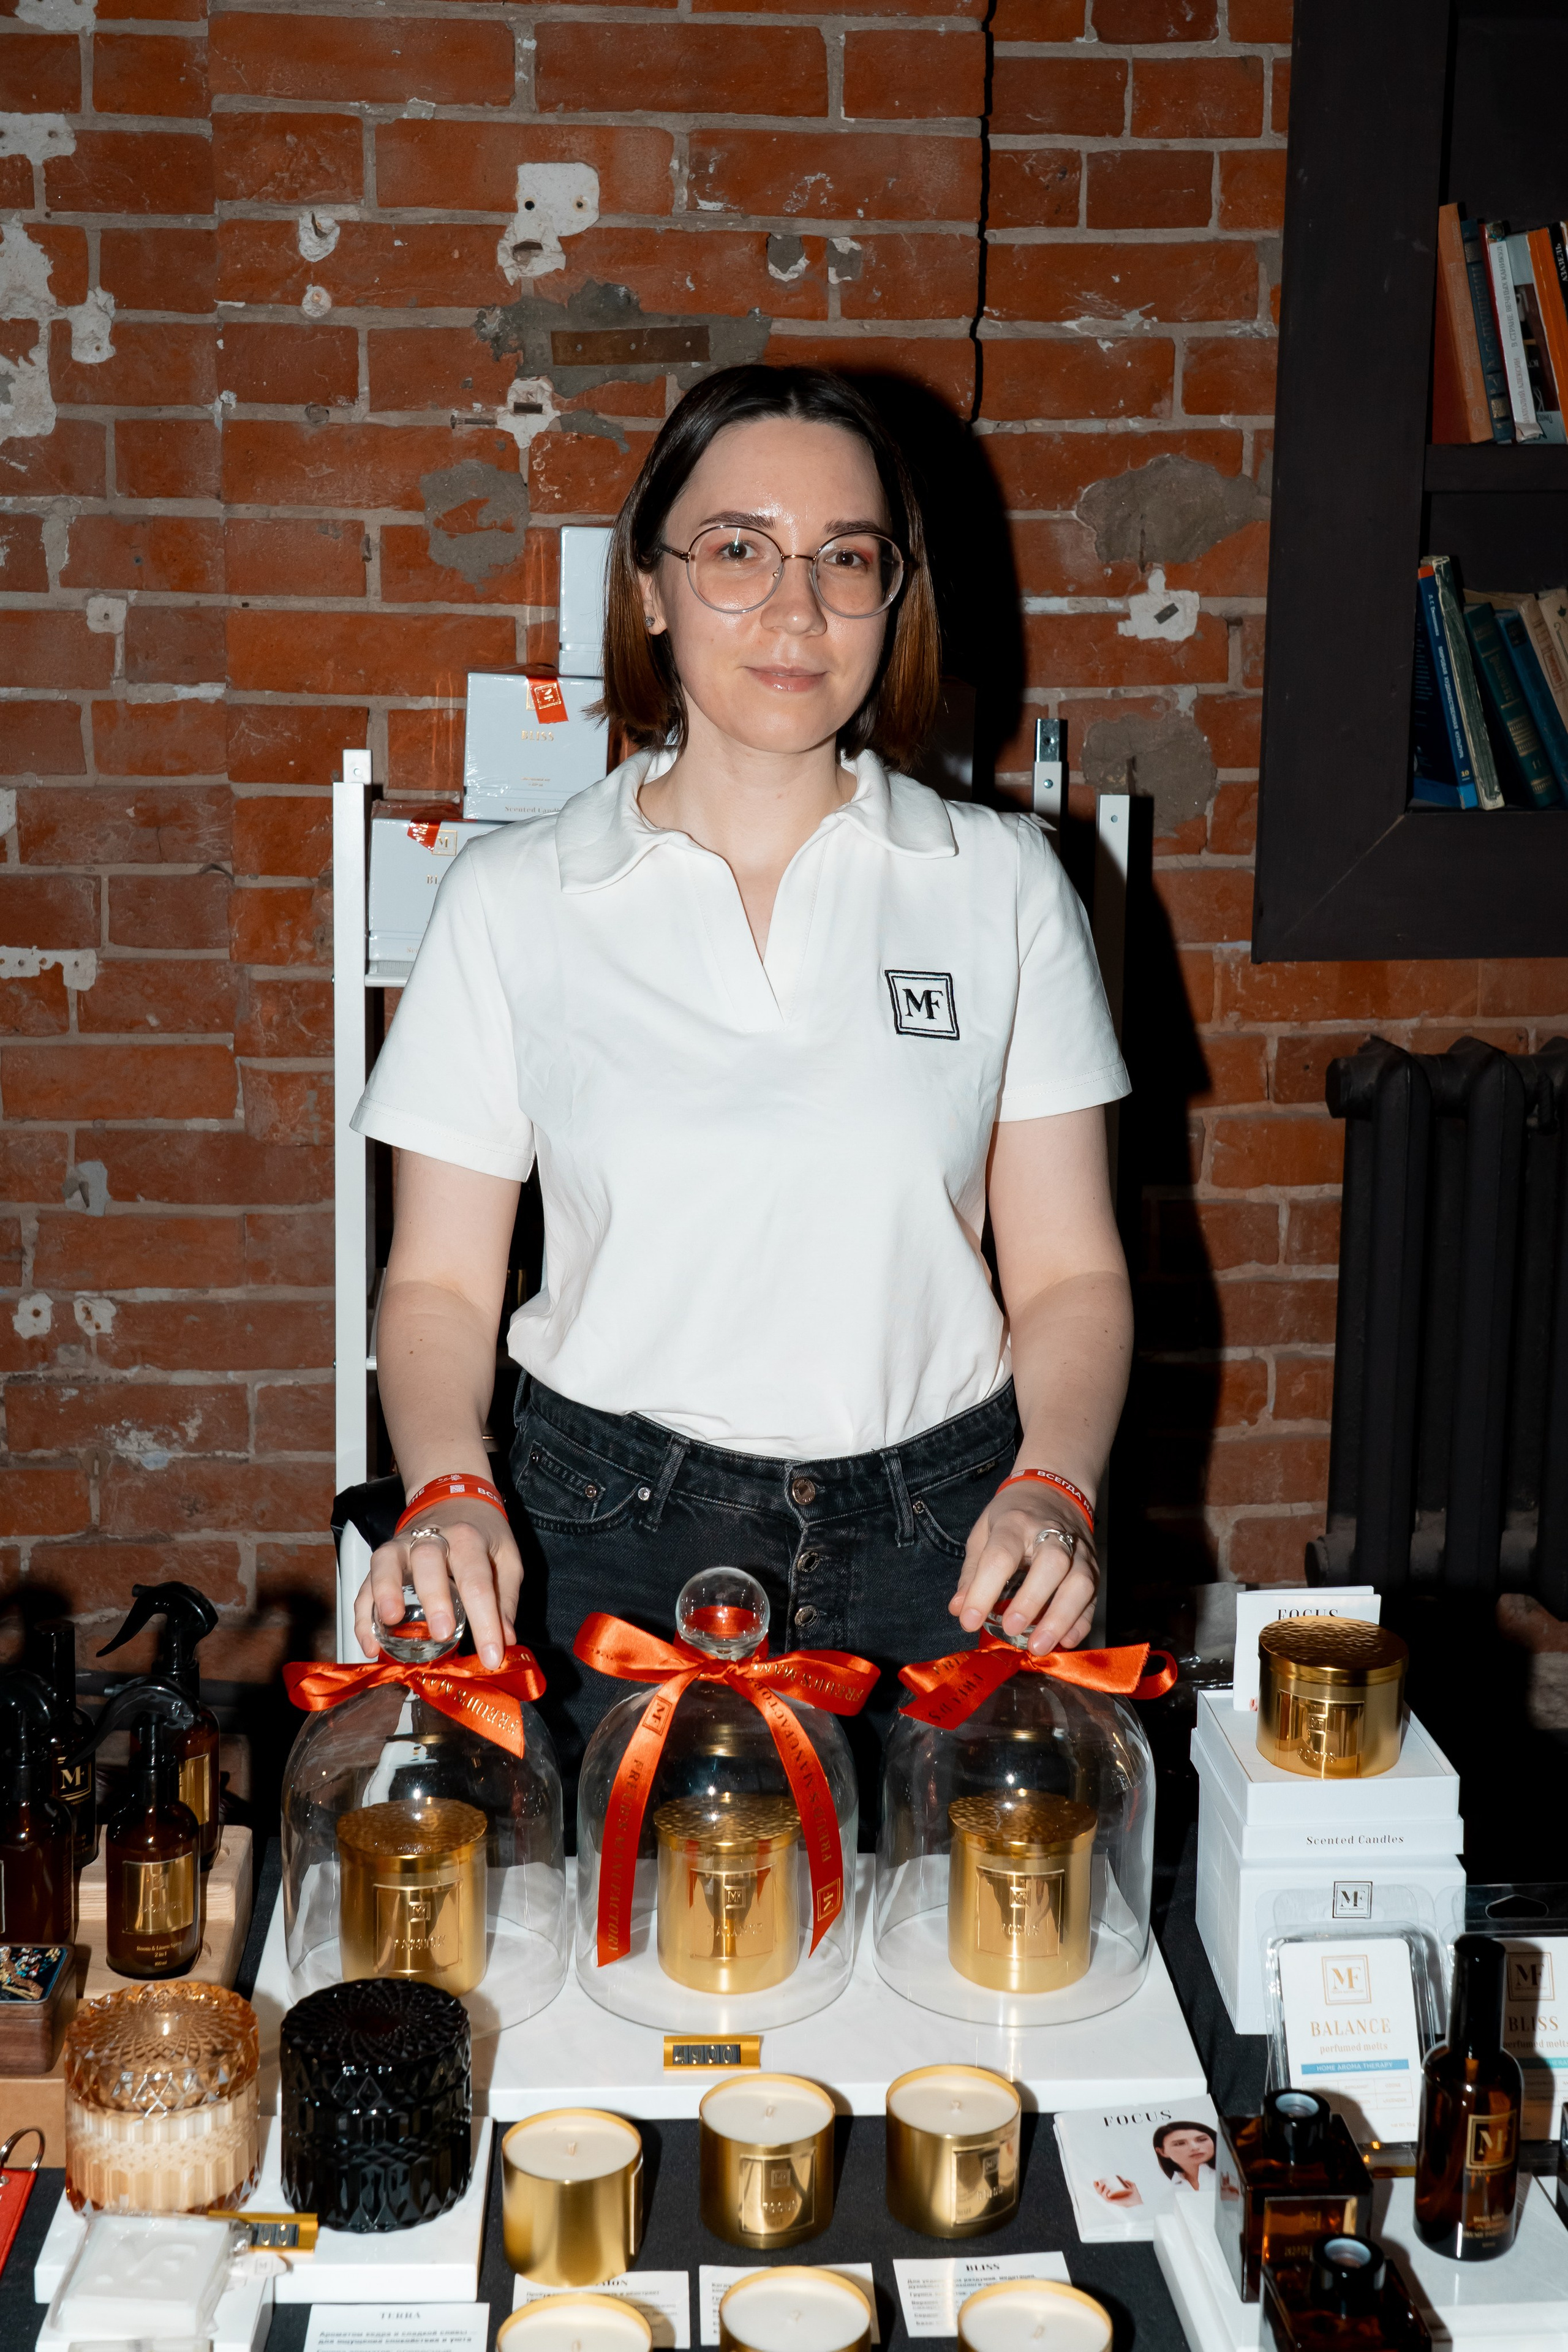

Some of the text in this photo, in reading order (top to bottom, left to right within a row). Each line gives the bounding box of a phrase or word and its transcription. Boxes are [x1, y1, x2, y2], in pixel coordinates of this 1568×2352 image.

[1497, 246, 1507, 281] КАНИКУЛ
[1501, 282, 1512, 312] ВЕЧНЫХ
[1507, 312, 1517, 341] СТРАНЕ
[521, 730, 554, 742] BLISS
[902, 988, 943, 1019] MF
[1037, 1470, 1082, 1501] ВСЕГДА
[1306, 1834, 1404, 1845] Scented Candles
[1340, 1890, 1366, 1907] MF
[1331, 1966, 1362, 1989] MF
[1310, 2018, 1391, 2037] BALANCE
[1508, 2016, 1559, 2032] BLISS
[674, 2045, 733, 2064] 4900
[1320, 2041, 1388, 2056] perfumed melts
[1104, 2109, 1172, 2127] FOCUS
[966, 2263, 1000, 2272] BLISS
